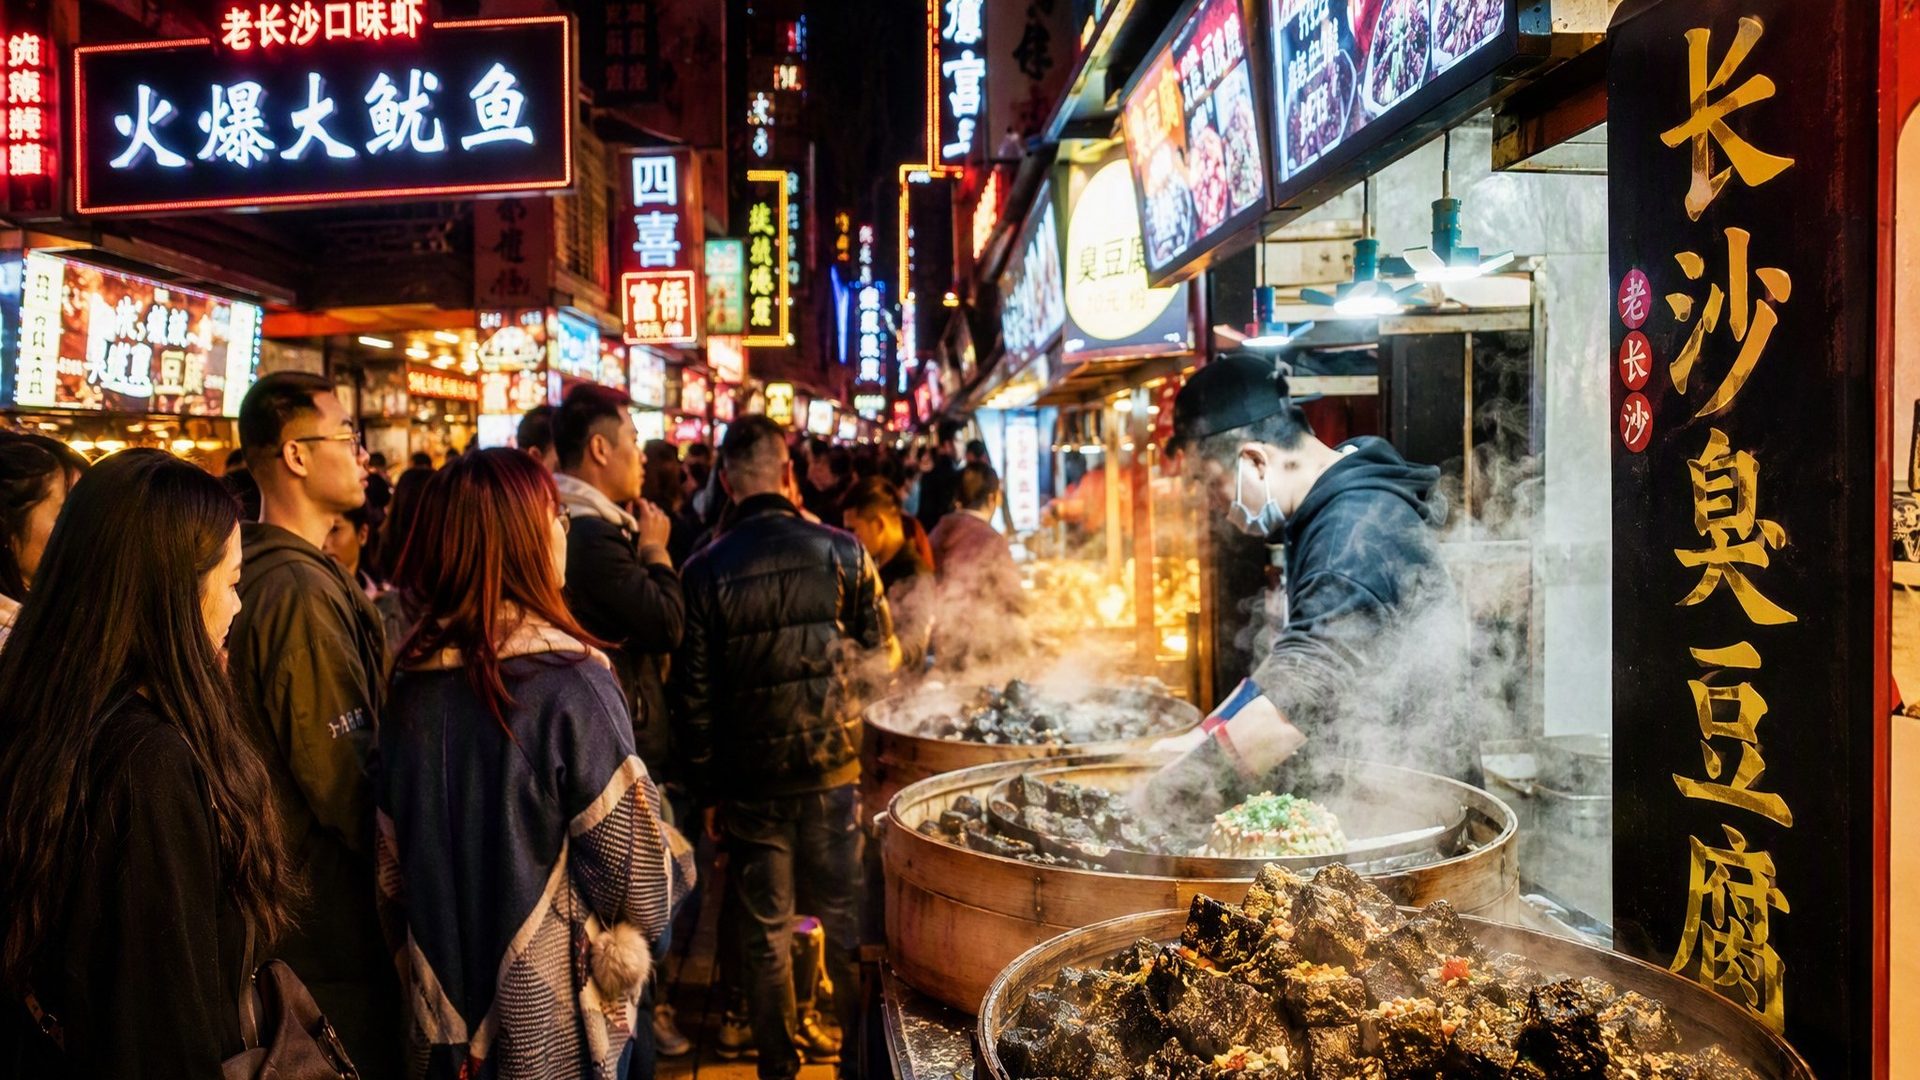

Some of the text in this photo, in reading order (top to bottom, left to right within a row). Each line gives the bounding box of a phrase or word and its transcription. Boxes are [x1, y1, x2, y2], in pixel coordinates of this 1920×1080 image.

[221, 0, 423, 50] 老长沙口味虾
[110, 63, 535, 168] 火爆大鱿鱼
[632, 156, 681, 267] 四喜
[1621, 277, 1650, 444] 老长沙
[1660, 17, 1797, 1035] 长沙臭豆腐
